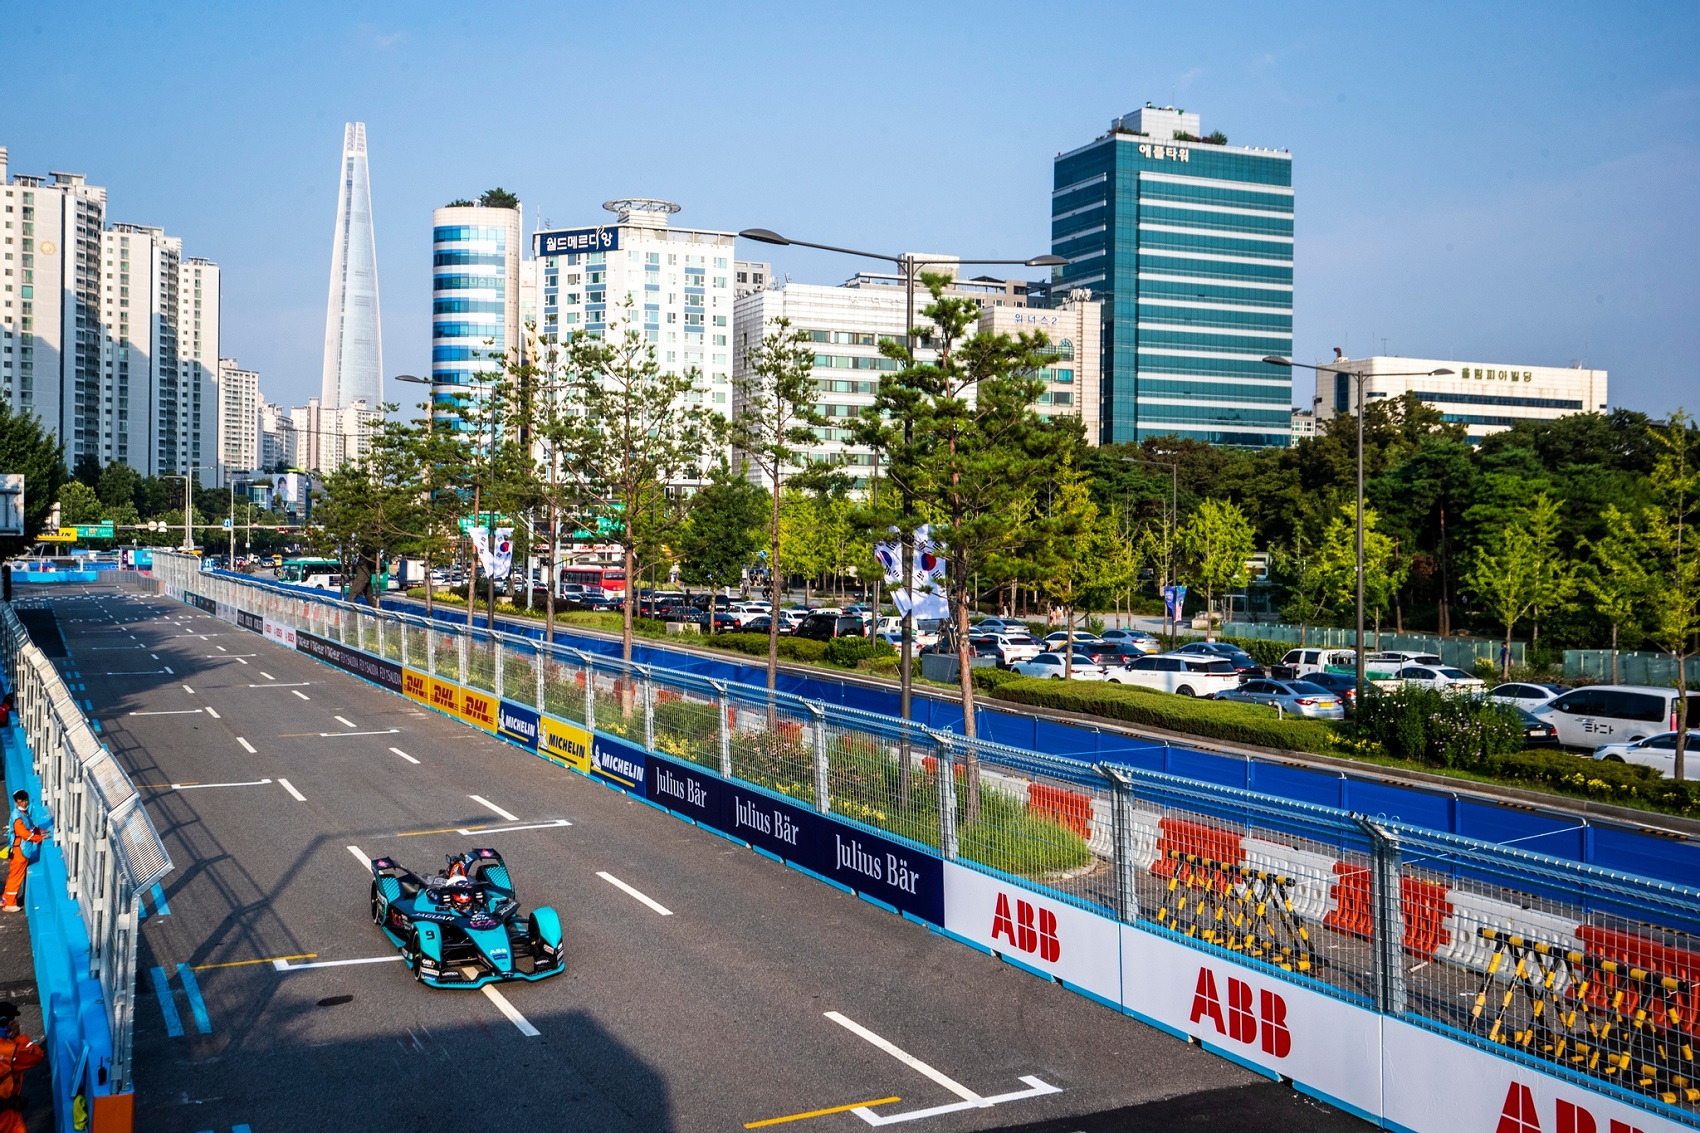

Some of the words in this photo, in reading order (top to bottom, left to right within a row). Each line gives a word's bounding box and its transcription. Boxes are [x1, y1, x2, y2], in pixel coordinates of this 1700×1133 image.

[1138, 144, 1190, 163] 애플타워
[545, 225, 613, 252] 월드메르디앙
[1461, 367, 1532, 382] 올림피아빌딩
[406, 675, 426, 697] DHL
[433, 684, 455, 709] DHL
[464, 695, 490, 723] DHL
[505, 714, 536, 738] MICHELIN
[548, 733, 586, 759] MICHELIN
[601, 751, 645, 782] MICHELIN
[655, 766, 685, 799] Julius
[687, 777, 708, 808] Bär
[734, 795, 771, 834] Julius
[774, 810, 800, 846] Bär
[835, 833, 882, 880] Julius
[886, 852, 920, 895] Bär
[411, 912, 455, 921] JAGUAR
[991, 892, 1061, 963] ABB
[425, 930, 435, 941] 9
[1190, 966, 1292, 1059] ABB
